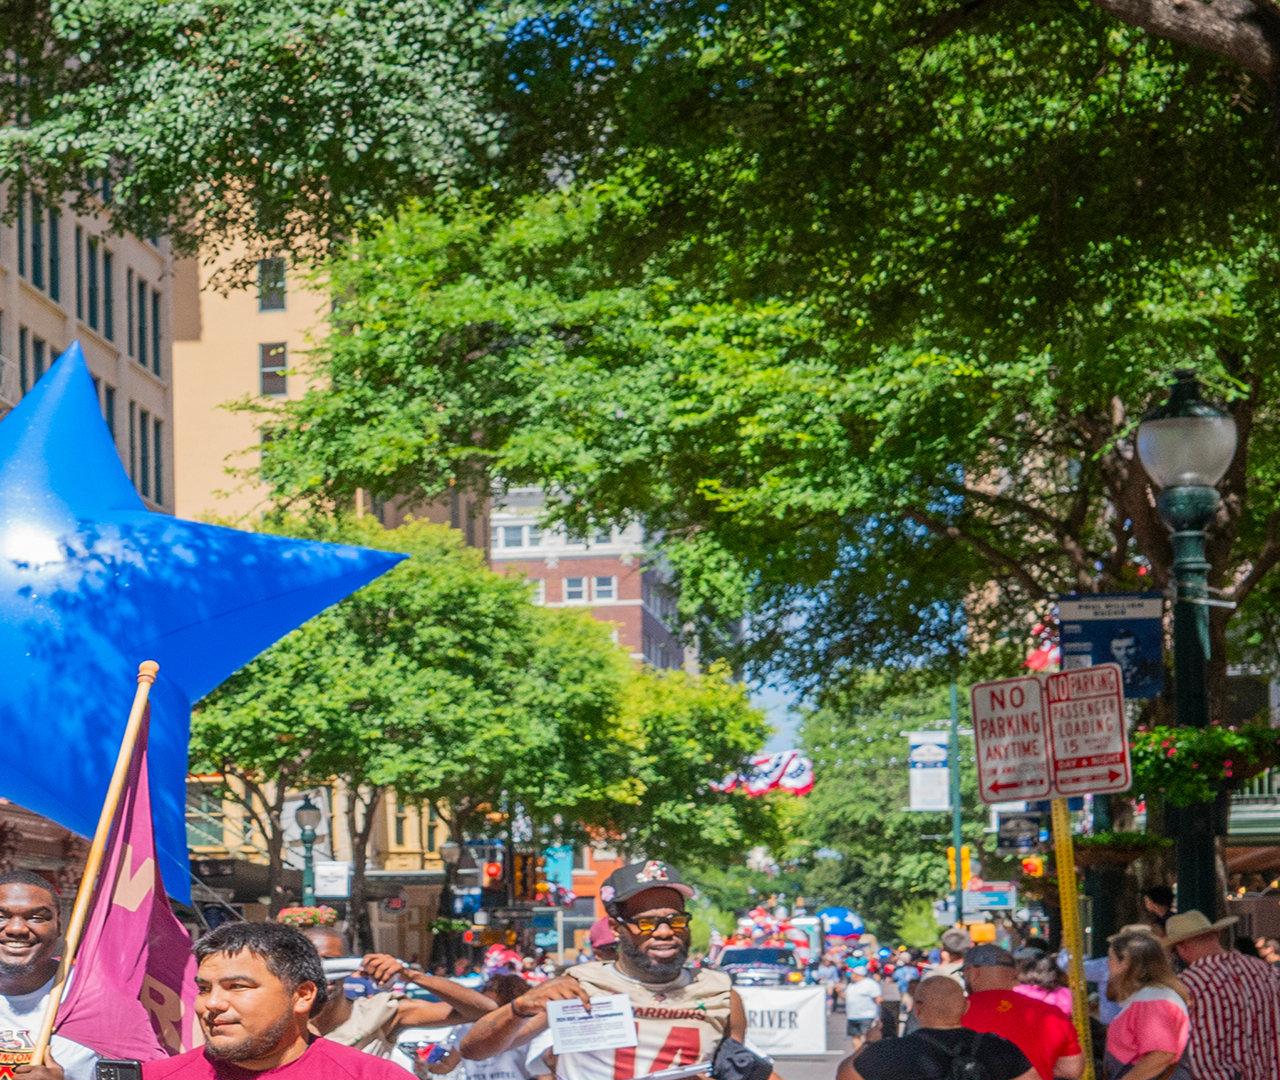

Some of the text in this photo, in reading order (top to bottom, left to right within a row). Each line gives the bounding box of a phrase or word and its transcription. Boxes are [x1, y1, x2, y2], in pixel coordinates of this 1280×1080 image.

[1049, 671, 1115, 700] NO PARKING
[990, 686, 1025, 710] NO
[1053, 699, 1116, 719] PASSENGER
[980, 712, 1040, 740] PARKING
[1057, 717, 1114, 738] LOADING
[985, 739, 1039, 761] ANYTIME
[1063, 740, 1079, 753] 15
[634, 1006, 706, 1021] ARRIORS
[748, 1009, 799, 1029] RIVER
